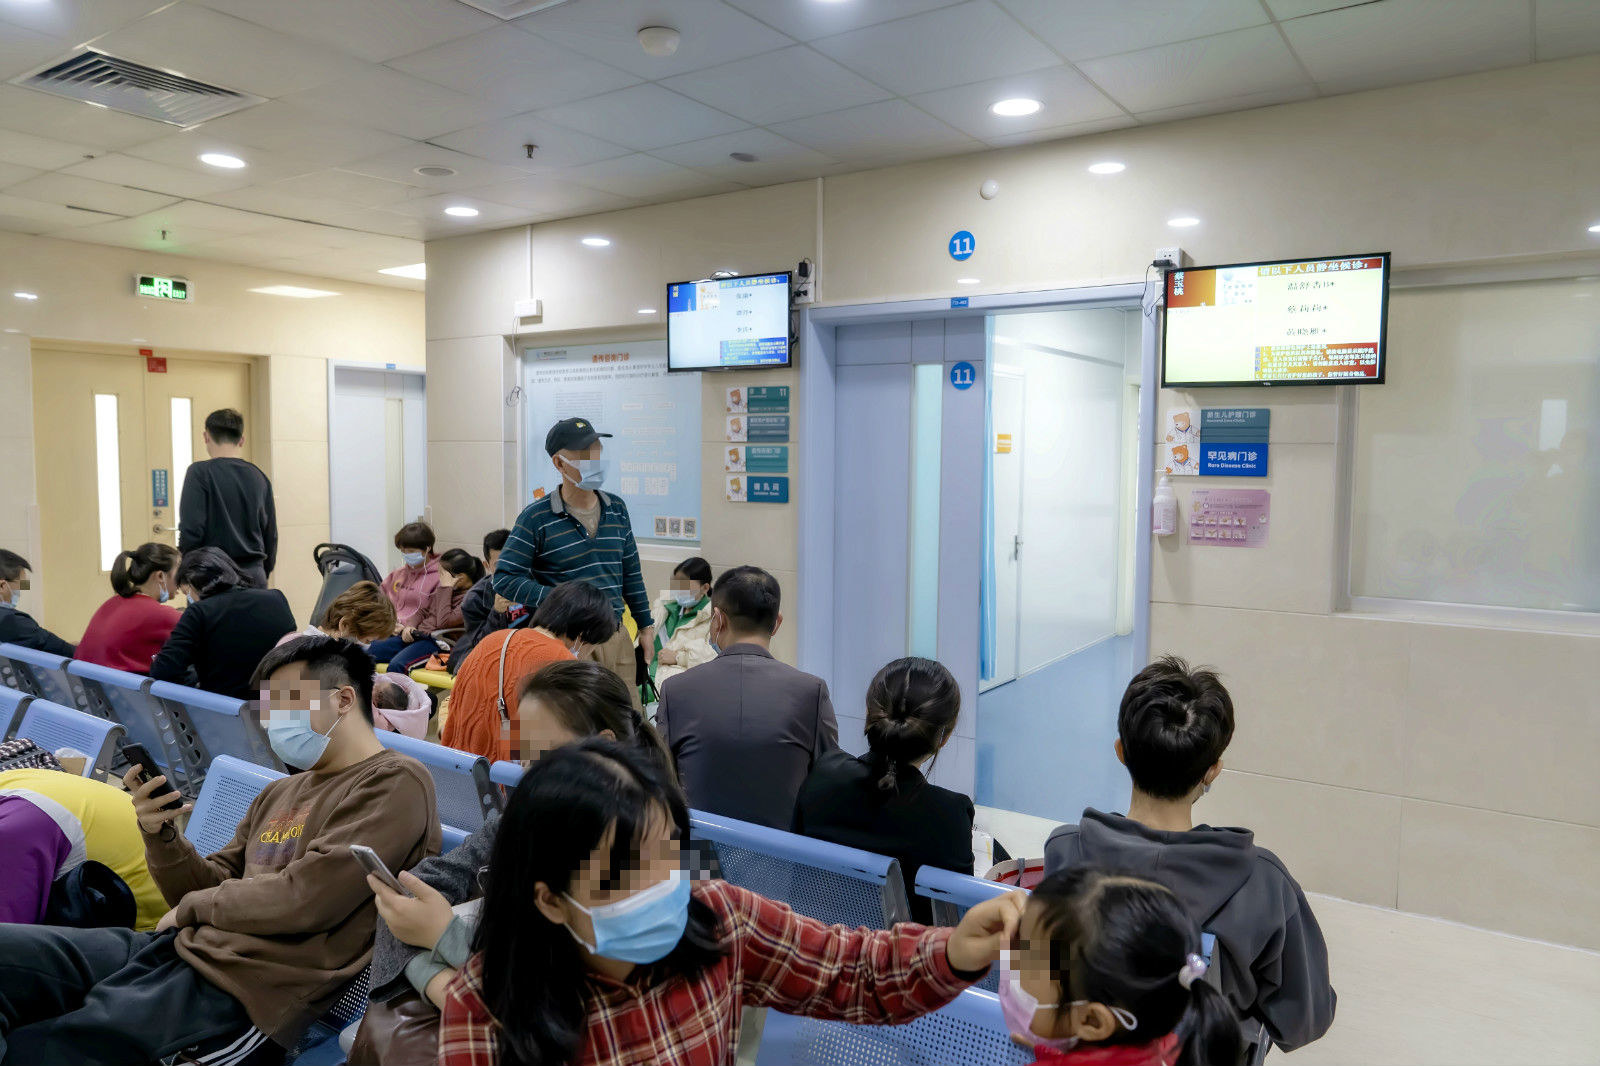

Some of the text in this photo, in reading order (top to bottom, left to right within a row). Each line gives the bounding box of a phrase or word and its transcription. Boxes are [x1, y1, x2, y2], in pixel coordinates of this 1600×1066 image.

[953, 237, 972, 256] 11
[953, 368, 972, 385] 11
[1207, 450, 1258, 461] 罕见病门诊
